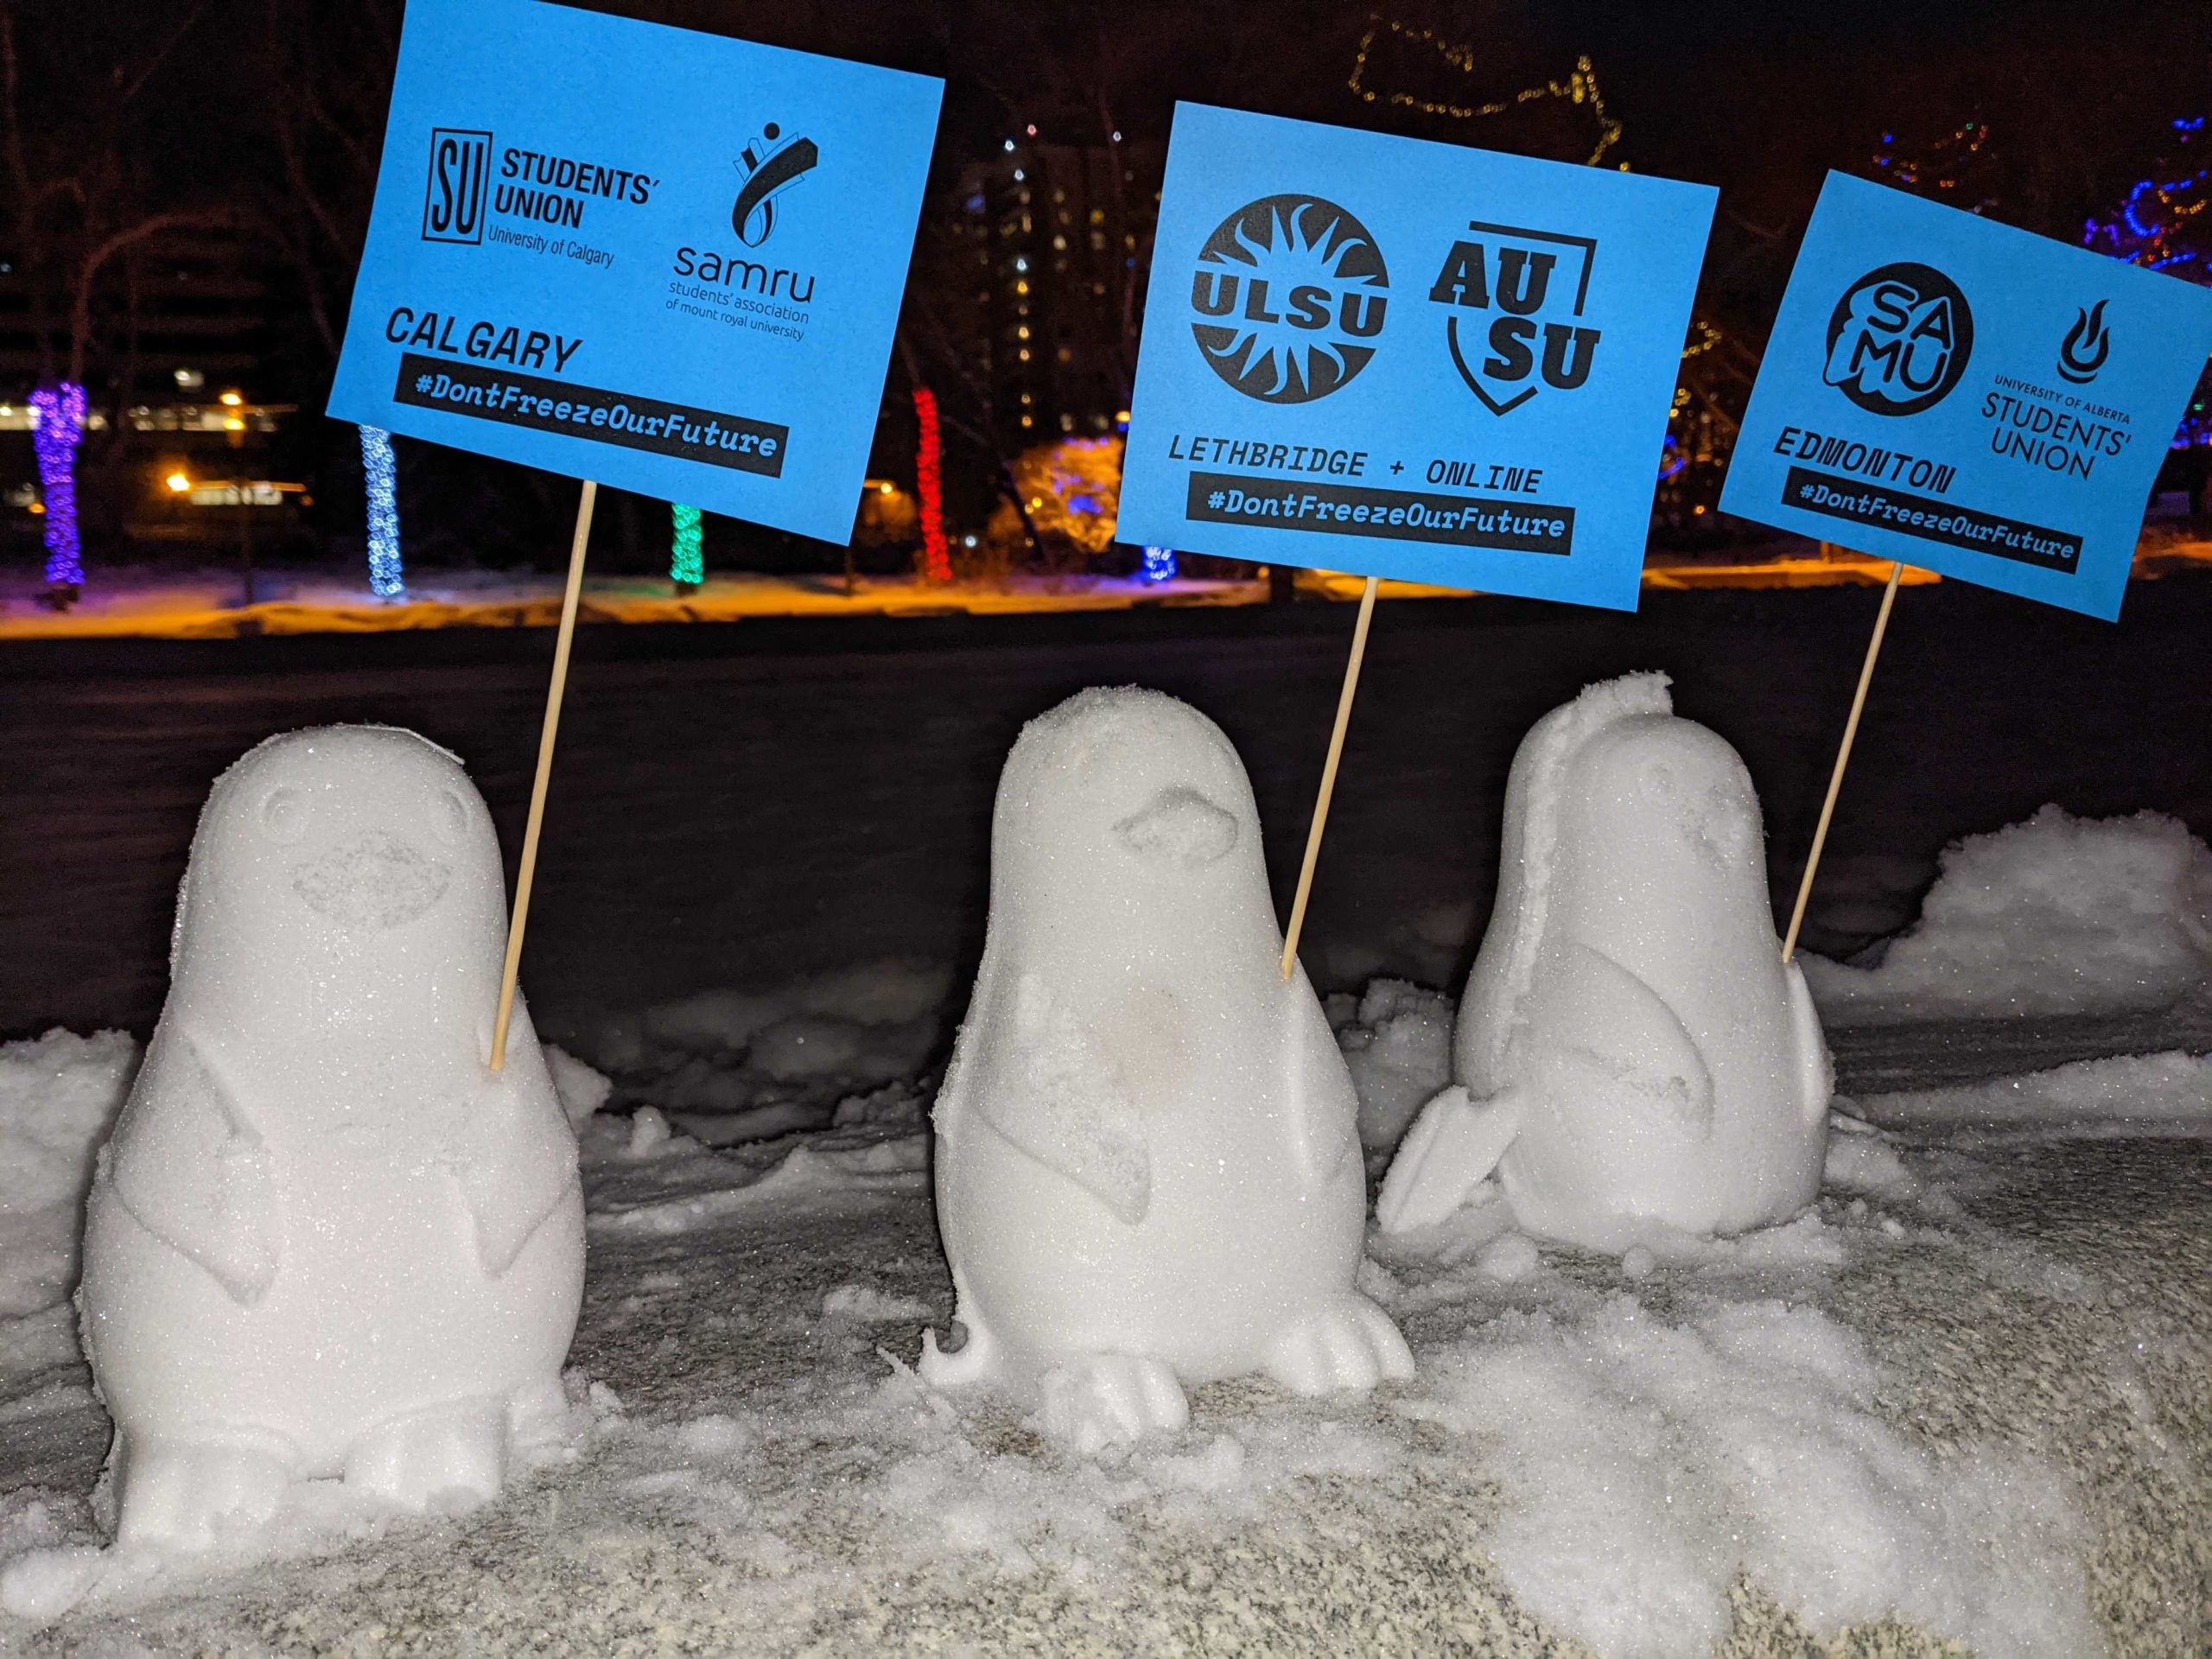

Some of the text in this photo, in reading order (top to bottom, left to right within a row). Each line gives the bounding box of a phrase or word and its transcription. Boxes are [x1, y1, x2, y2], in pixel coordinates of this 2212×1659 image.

[494, 183, 584, 229] UNION
[487, 226, 615, 269] University of Calgary
[672, 246, 816, 304] samru
[665, 298, 804, 342] of mount royal university
[734, 292, 810, 324] association
[1191, 270, 1388, 338] ULSU
[385, 306, 583, 373] CALGARY
[415, 372, 778, 457] #DontFreezeOurFuture
[1995, 374, 2130, 424] UNIVERSITY OF ALBERTA
[1168, 435, 1543, 493] LETHBRIDGE + ONLINE
[1773, 427, 1957, 494] EDMONTON
[1991, 428, 2095, 480] UNION
[1207, 489, 1566, 537] #DontFreezeOurFuture
[1800, 483, 2075, 558] #DontFreezeOurFuture
